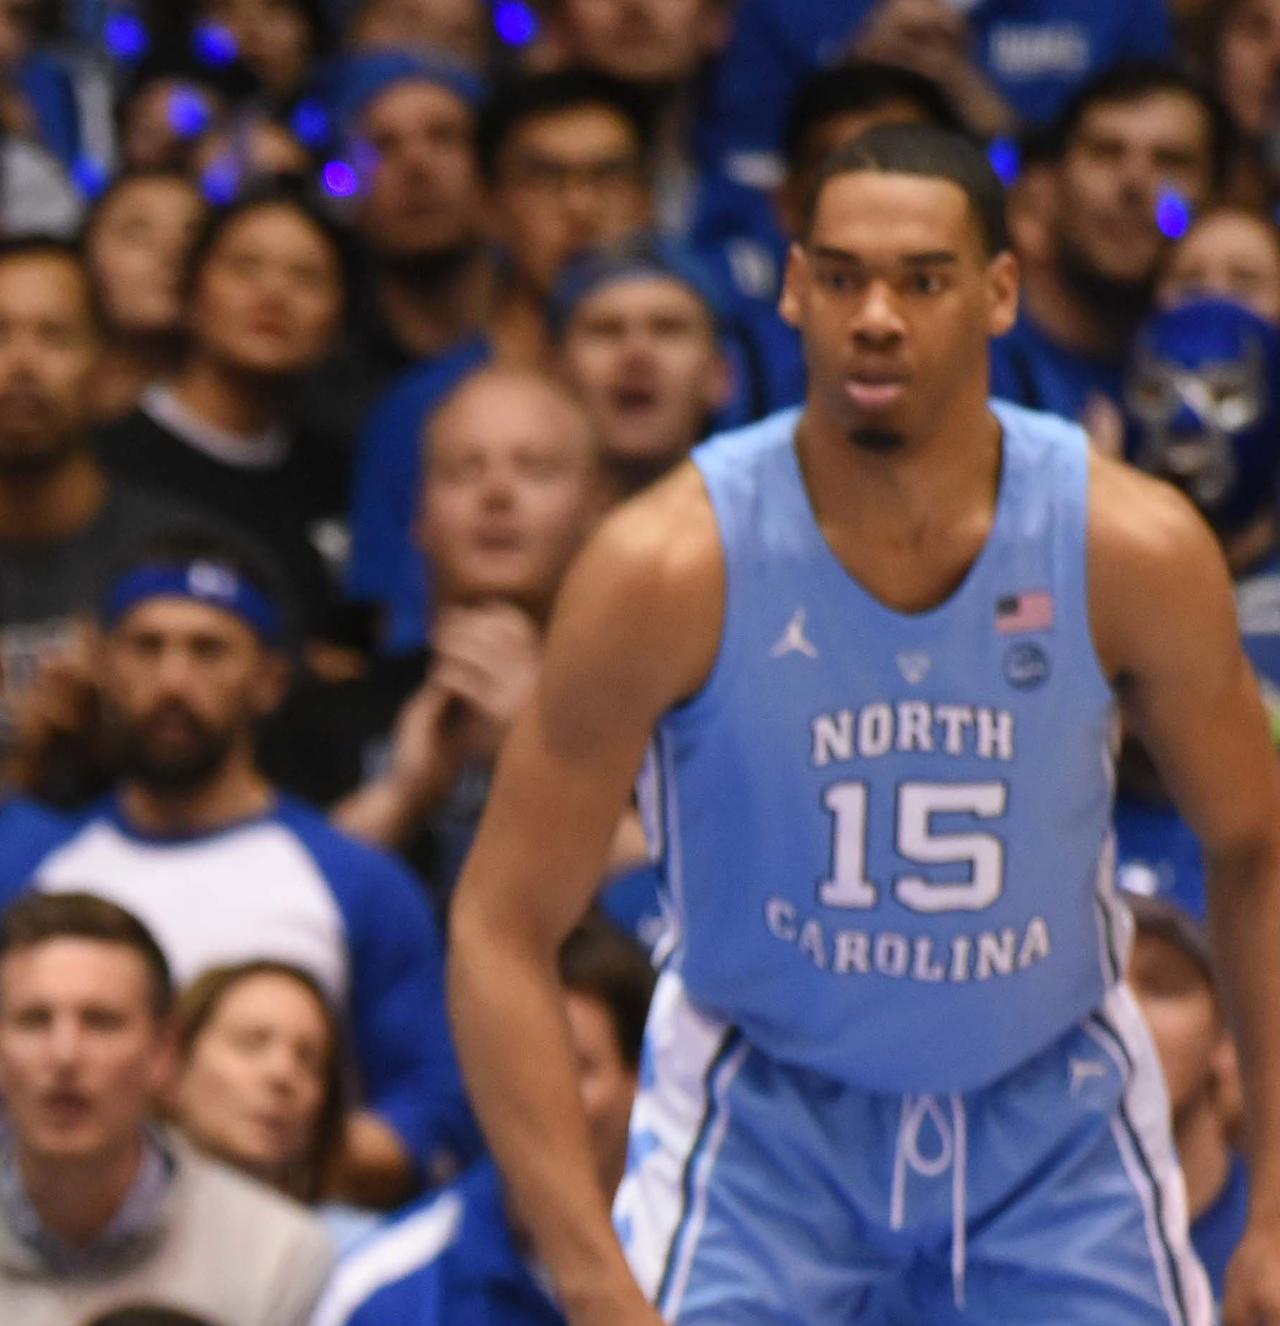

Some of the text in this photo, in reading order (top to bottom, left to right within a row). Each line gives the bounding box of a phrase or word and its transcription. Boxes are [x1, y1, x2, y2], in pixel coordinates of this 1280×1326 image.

[811, 698, 1014, 767] NORTH
[816, 780, 1007, 913] 15
[763, 896, 1052, 982] CAROLINA
